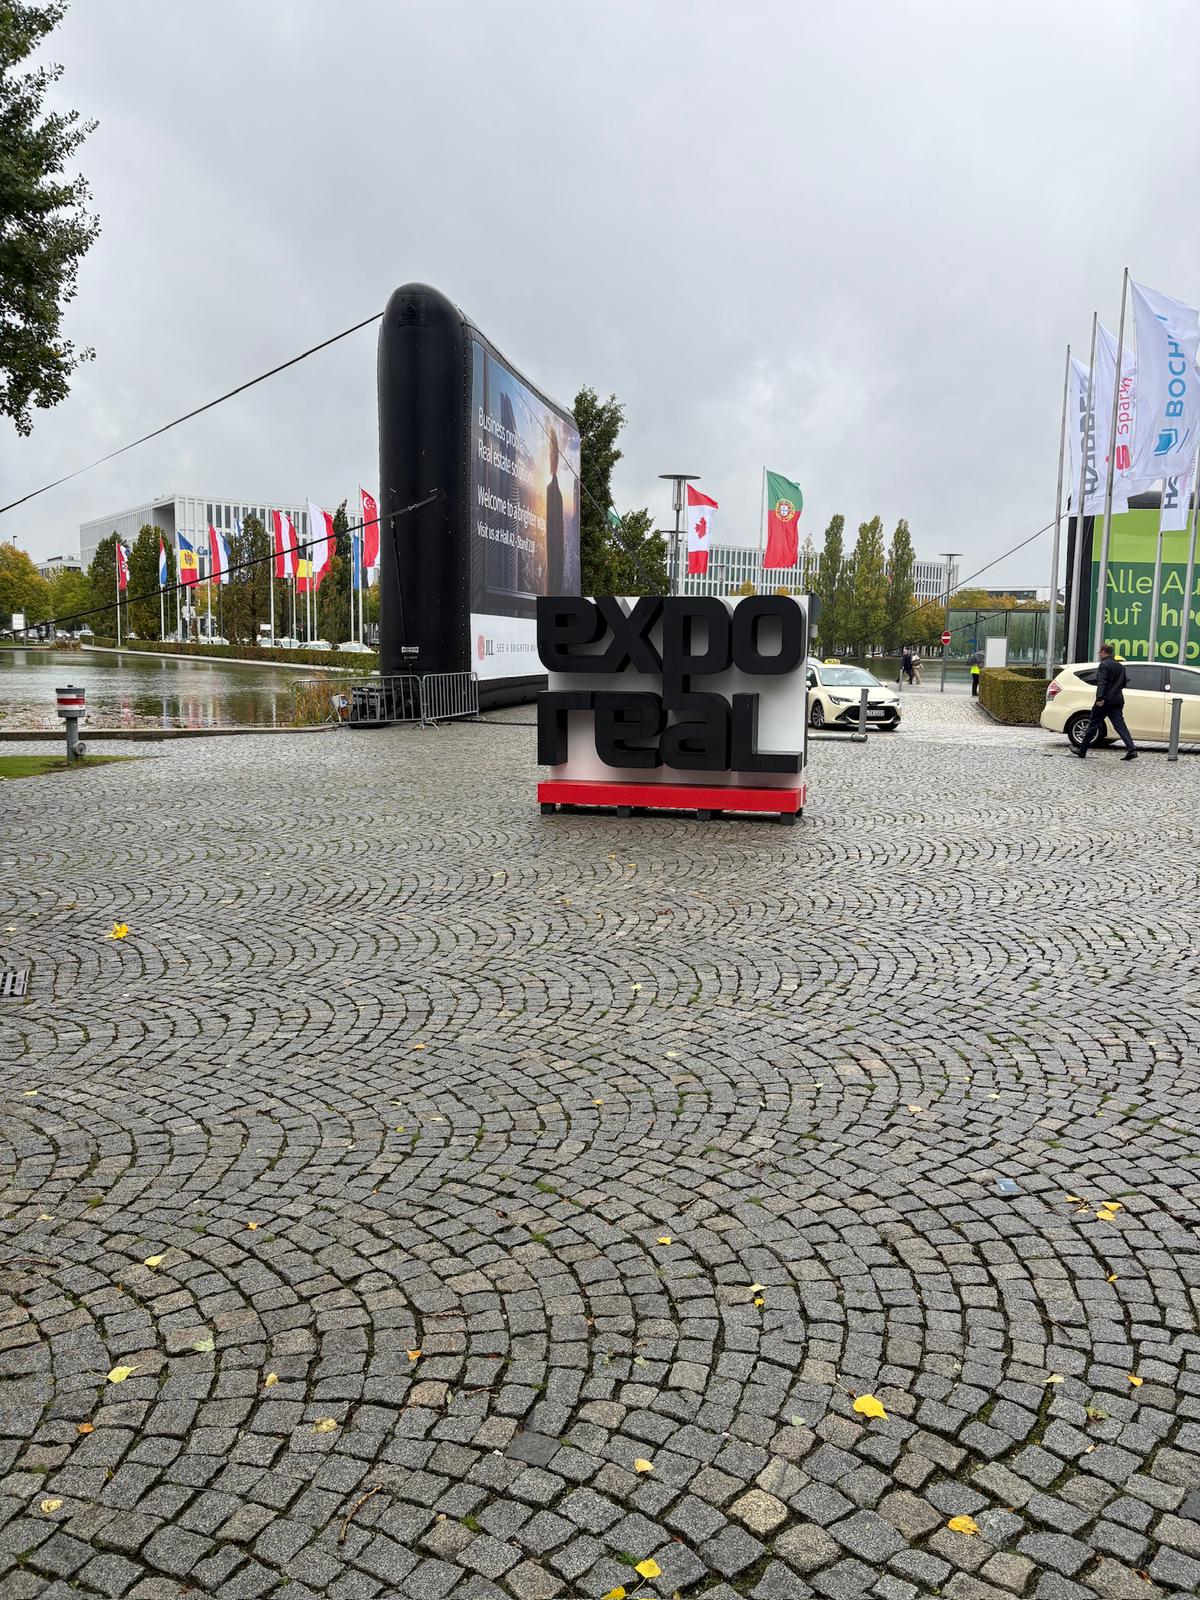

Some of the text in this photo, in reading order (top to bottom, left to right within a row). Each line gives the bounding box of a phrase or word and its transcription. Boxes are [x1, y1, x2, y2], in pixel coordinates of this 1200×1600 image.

[1165, 334, 1188, 417] BOCH
[479, 406, 506, 440] Business
[478, 438, 492, 464] Real
[494, 450, 511, 474] estate
[478, 484, 506, 515] Welcome
[507, 499, 513, 517] to
[518, 501, 537, 529] brighter
[477, 520, 488, 539] Visit
[1097, 568, 1152, 594] Alle
[1104, 602, 1142, 625] auf
[537, 595, 806, 680] expo
